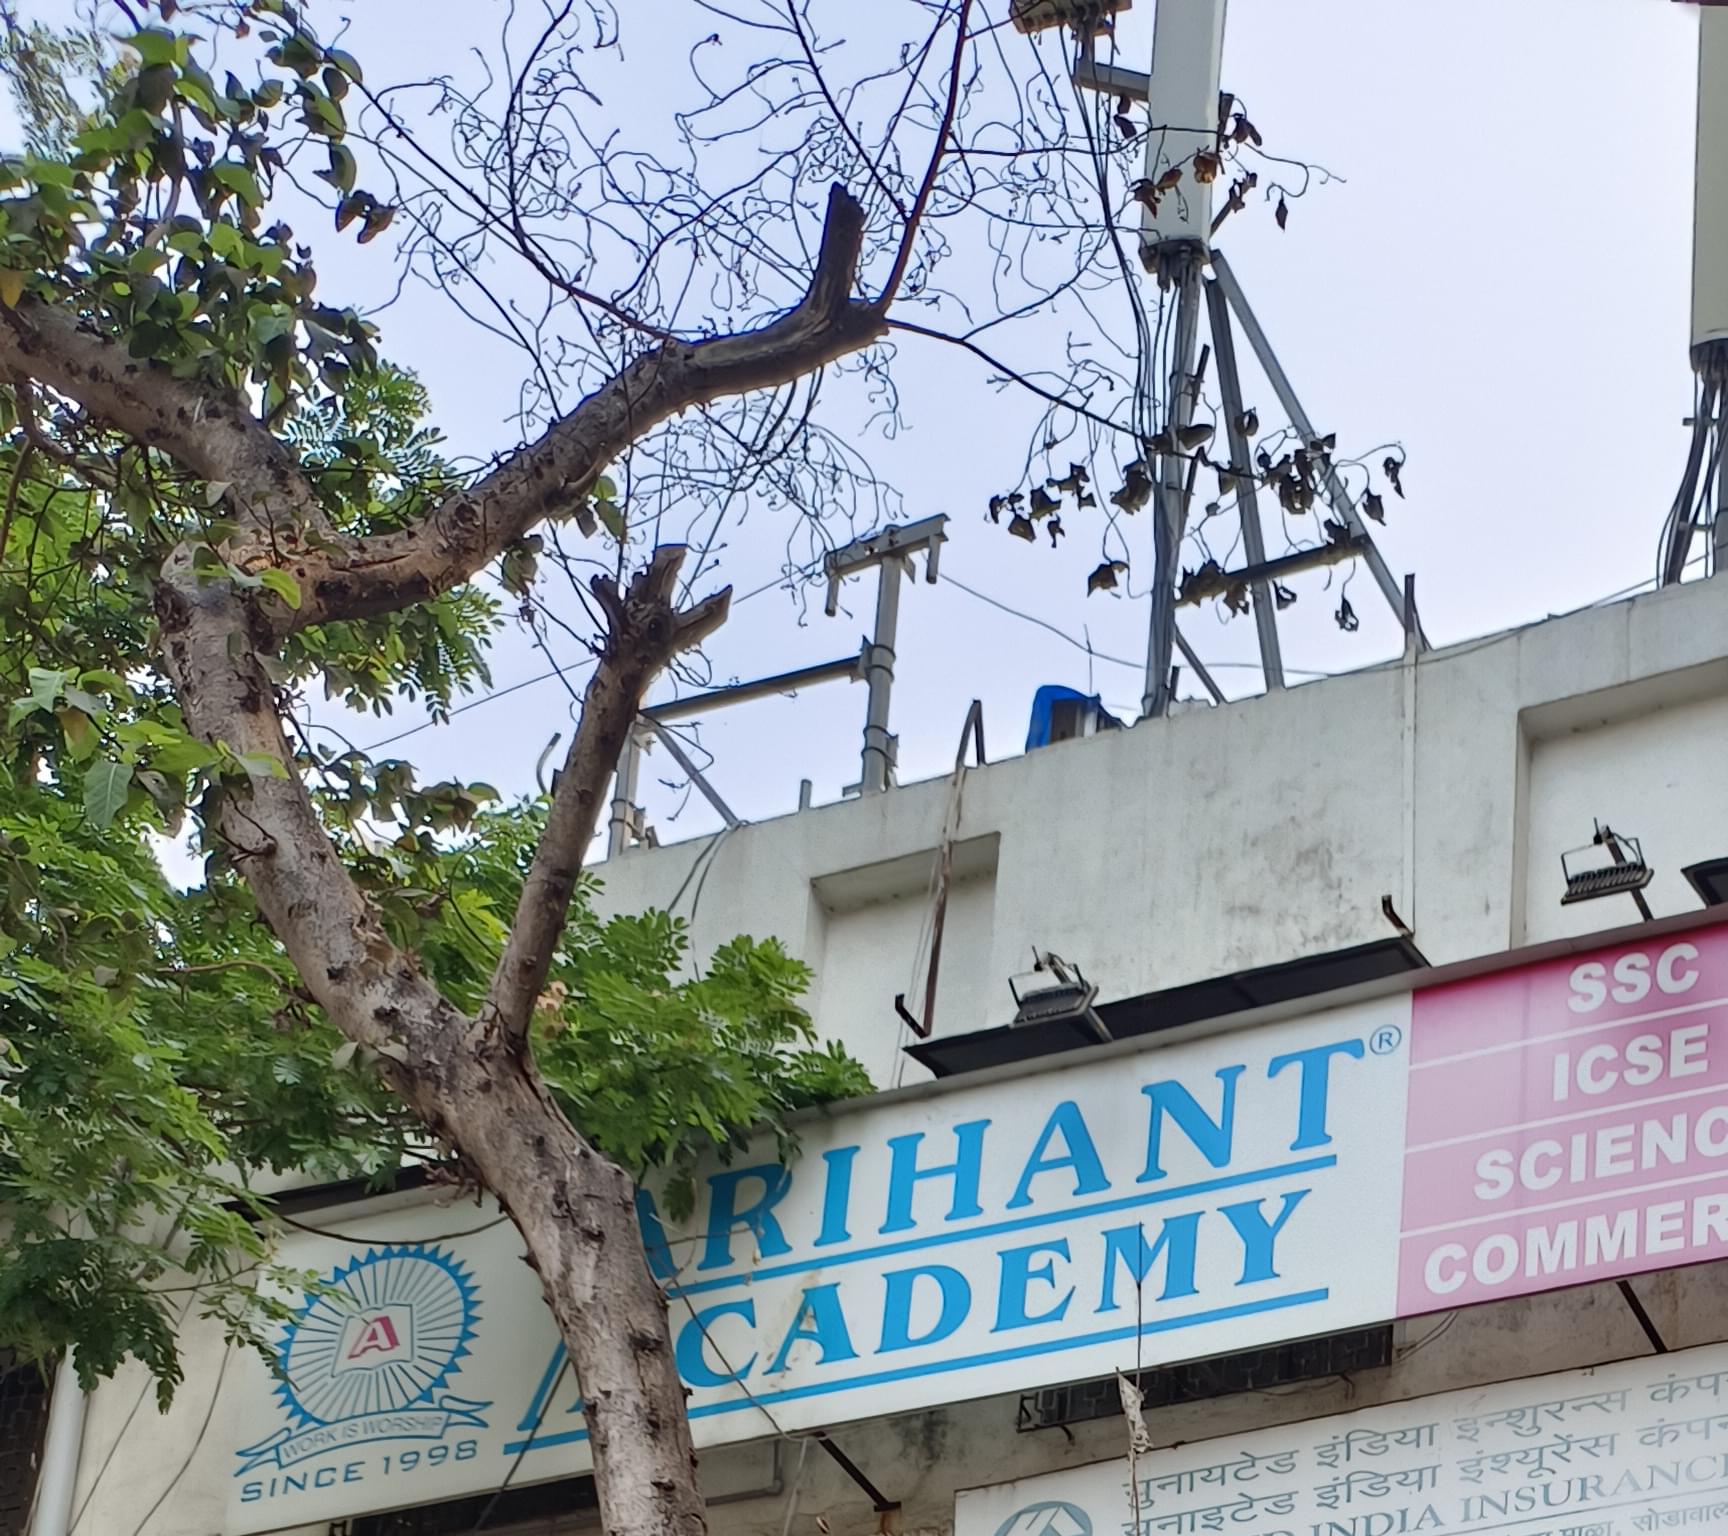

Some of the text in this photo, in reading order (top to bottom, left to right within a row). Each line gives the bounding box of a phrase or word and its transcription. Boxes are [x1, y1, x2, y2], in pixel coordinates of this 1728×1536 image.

[1567, 941, 1700, 1015] SSC
[1552, 1023, 1711, 1102] ICSE
[513, 1189, 1313, 1431] CADEMY
[283, 1416, 444, 1459] WORK IS WORSHIP
[1313, 1422, 1440, 1470] इंडिया
[240, 1439, 478, 1503] SINCE 1998
[1313, 1463, 1443, 1511] इंडिया
